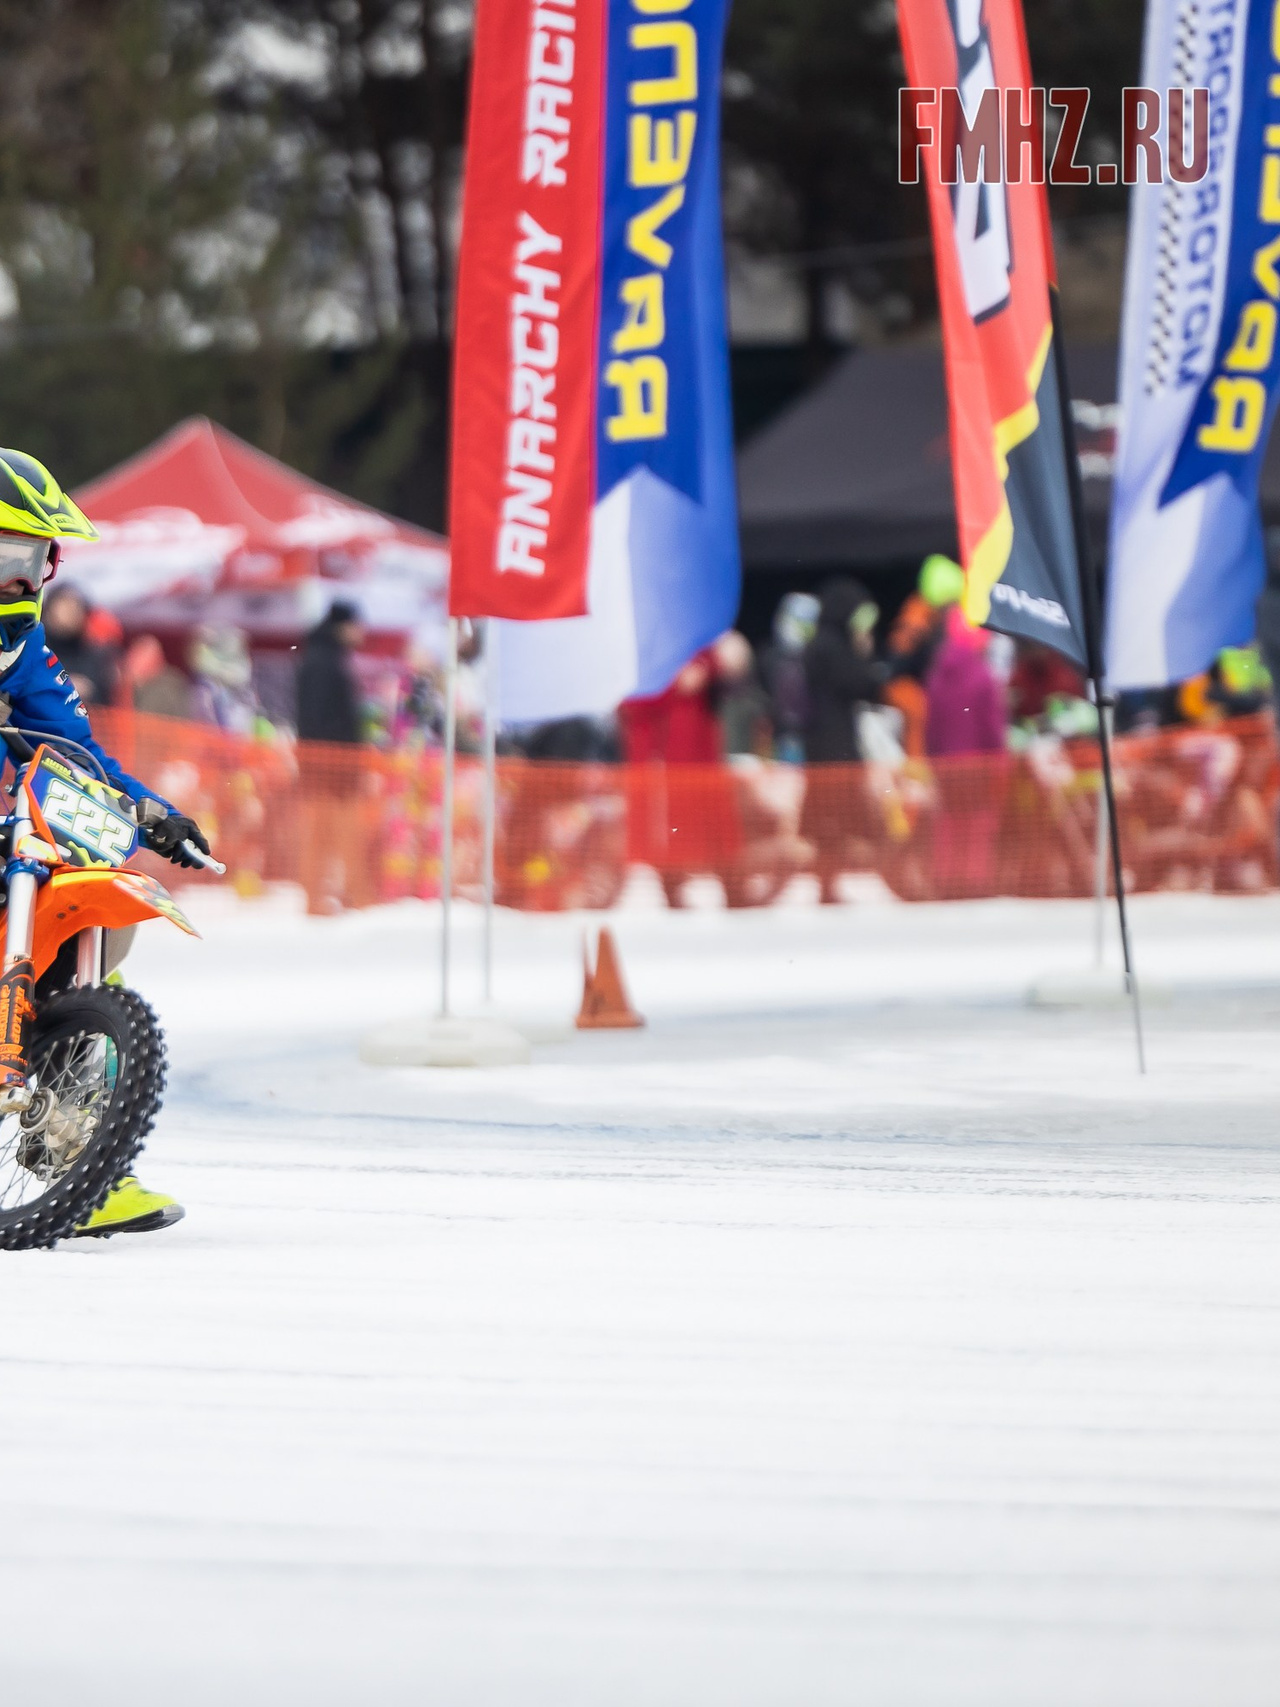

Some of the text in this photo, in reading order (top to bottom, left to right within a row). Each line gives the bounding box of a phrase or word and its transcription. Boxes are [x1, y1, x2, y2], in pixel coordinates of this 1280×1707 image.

[495, 0, 577, 577] ANARCHY RACI
[42, 778, 135, 866] 222
